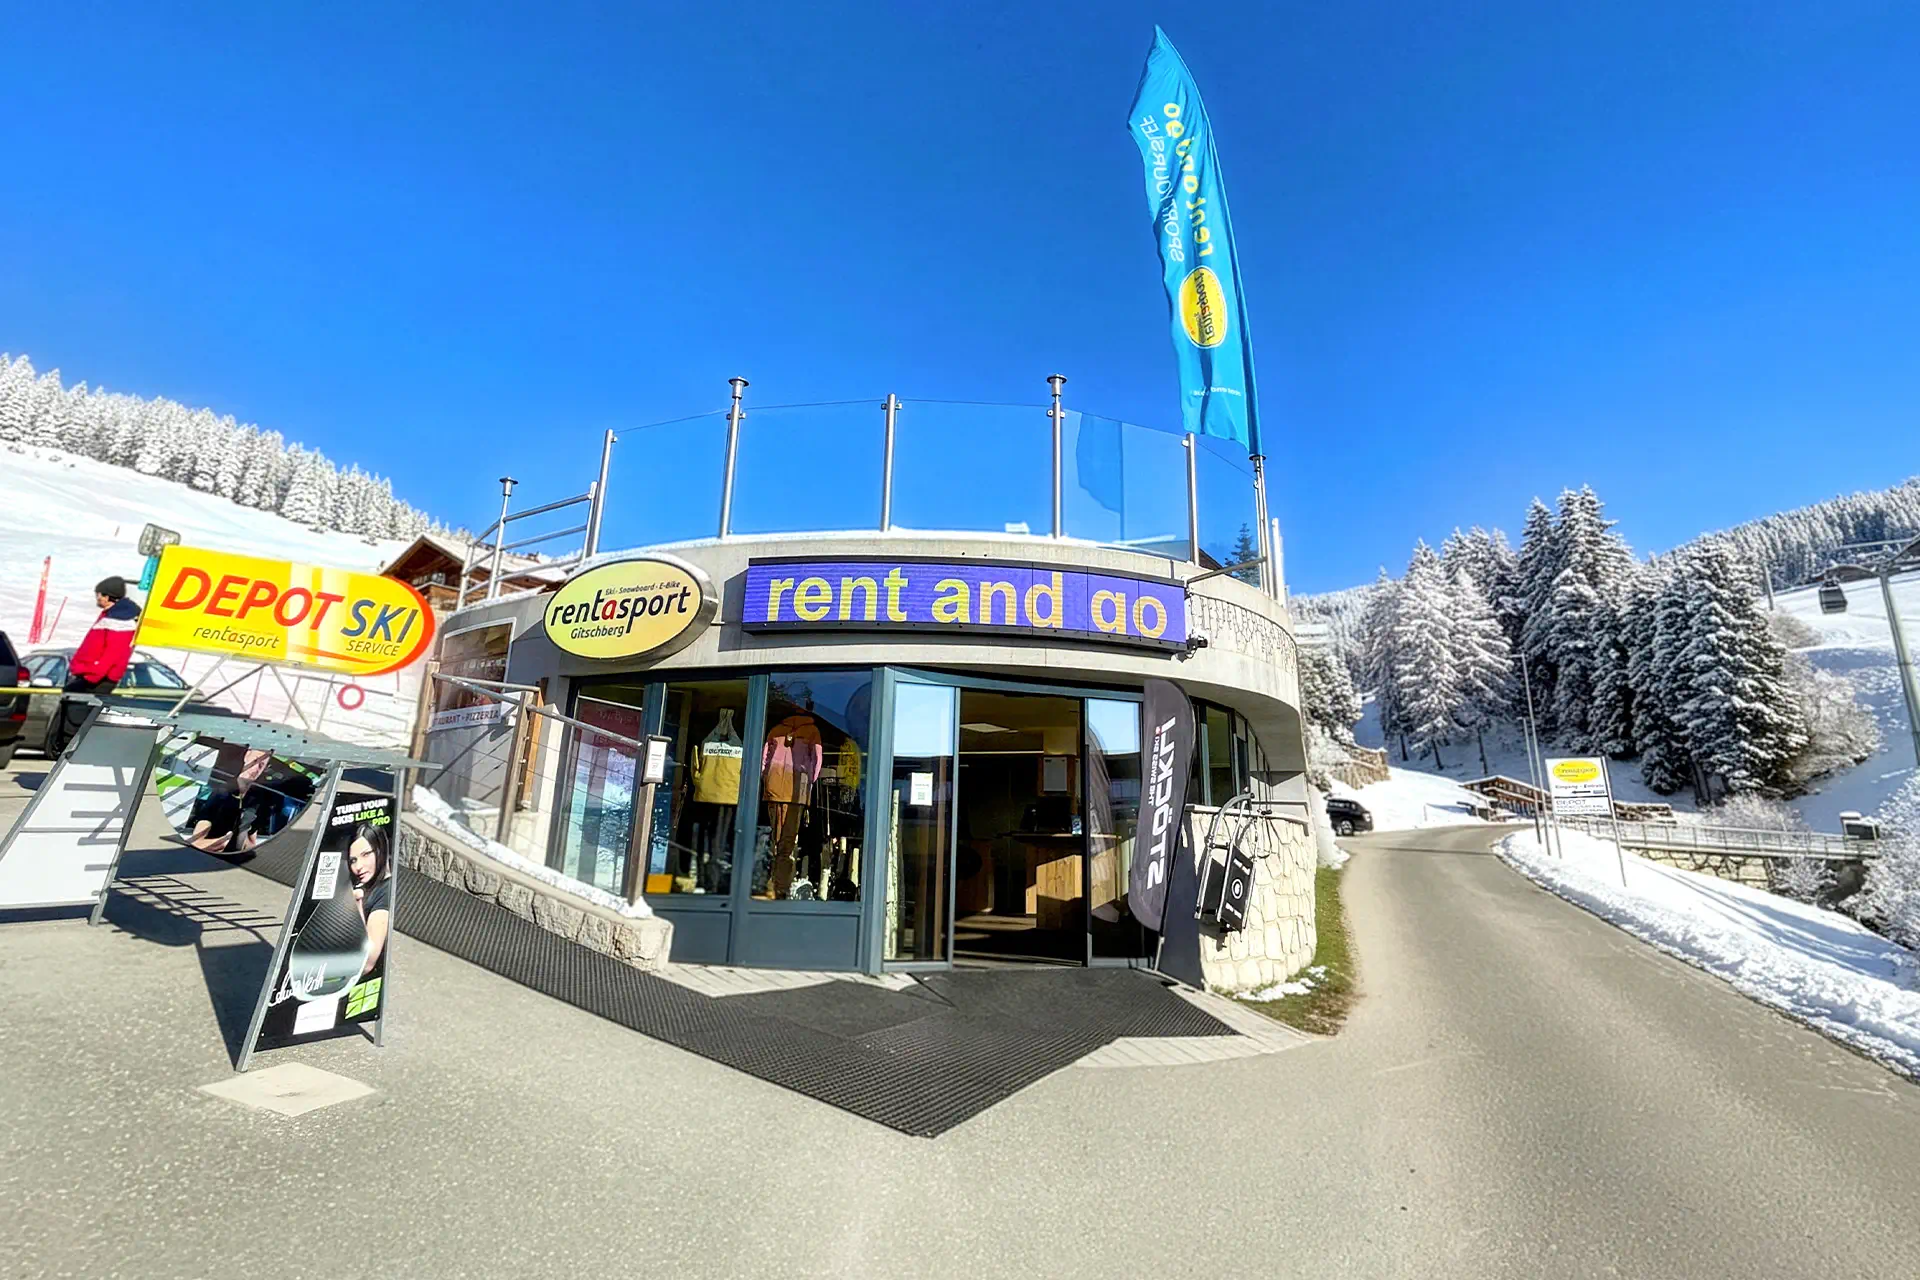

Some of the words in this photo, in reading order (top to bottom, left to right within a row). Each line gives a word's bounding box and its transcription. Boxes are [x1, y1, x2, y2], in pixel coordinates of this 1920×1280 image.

[160, 567, 345, 630] DEPOT
[340, 599, 419, 643] SKI
[767, 566, 908, 622] rent
[931, 571, 1063, 629] and
[550, 586, 691, 634] rentasport
[193, 625, 280, 651] rentasport
[570, 624, 625, 640] Gitschberg
[346, 639, 401, 656] SERVICE
[466, 709, 499, 722] PIZZERIA
[335, 802, 362, 816] TUNE
[362, 798, 388, 811] YOUR
[331, 813, 355, 827] SKIS
[355, 809, 377, 821] LIKE
[377, 808, 384, 818] A
[372, 815, 391, 827] PRO
